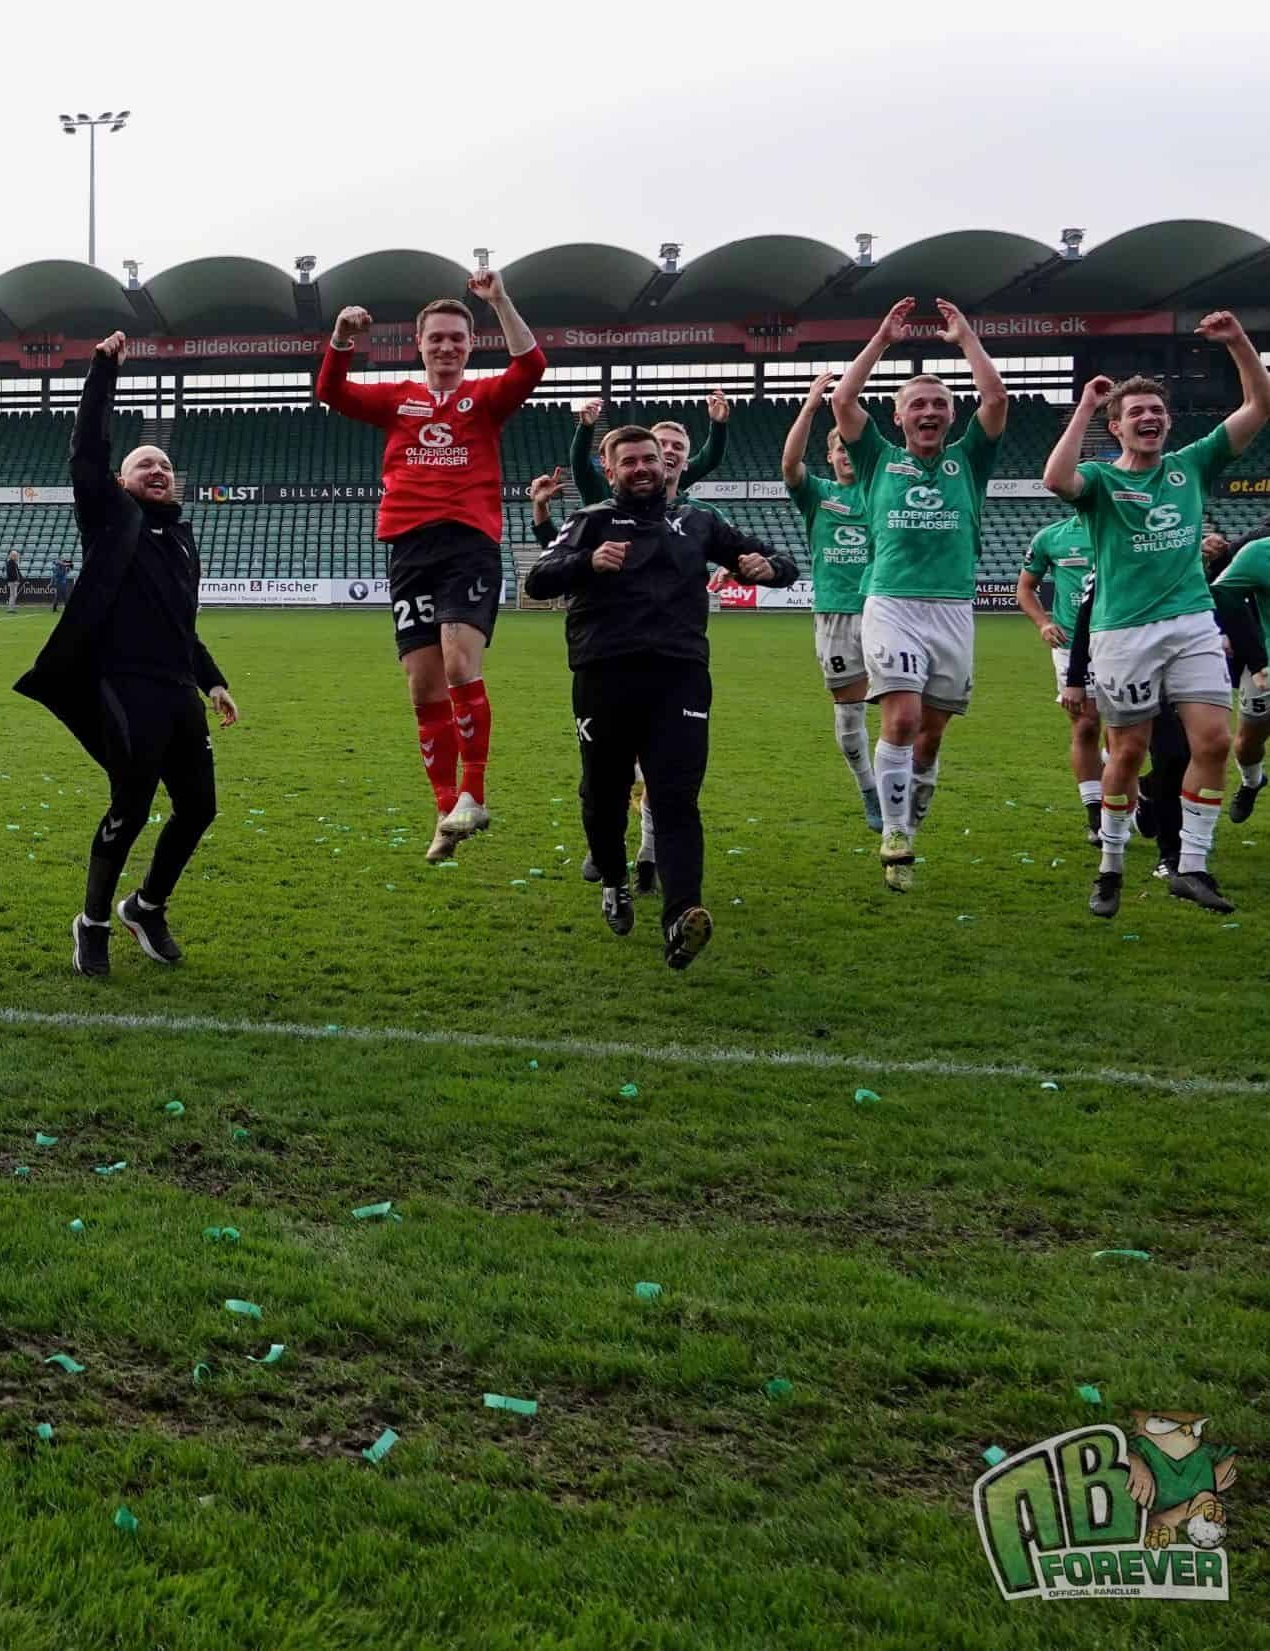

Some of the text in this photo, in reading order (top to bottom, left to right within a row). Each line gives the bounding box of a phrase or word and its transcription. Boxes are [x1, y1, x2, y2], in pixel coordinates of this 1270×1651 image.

[909, 317, 1087, 336] wwllaskilte.dk
[565, 327, 714, 346] Storformatprint
[184, 338, 321, 355] Bildekorationer
[406, 447, 468, 456] OLDENBORG
[199, 485, 259, 502] HOLST
[280, 487, 387, 498] BILLAKERIN
[753, 483, 789, 496] Phar
[887, 510, 960, 520] OLDENBORG
[887, 520, 959, 530] STILLADSER
[1132, 526, 1196, 543] OLDENBOR
[822, 547, 868, 556] OLDENBO
[823, 555, 868, 564] STILLADS
[200, 582, 246, 592] rmann
[267, 580, 318, 592] Fischer
[993, 597, 1019, 606] FISC
[394, 595, 434, 630] 25
[831, 656, 846, 673] 8
[900, 652, 917, 674] 11
